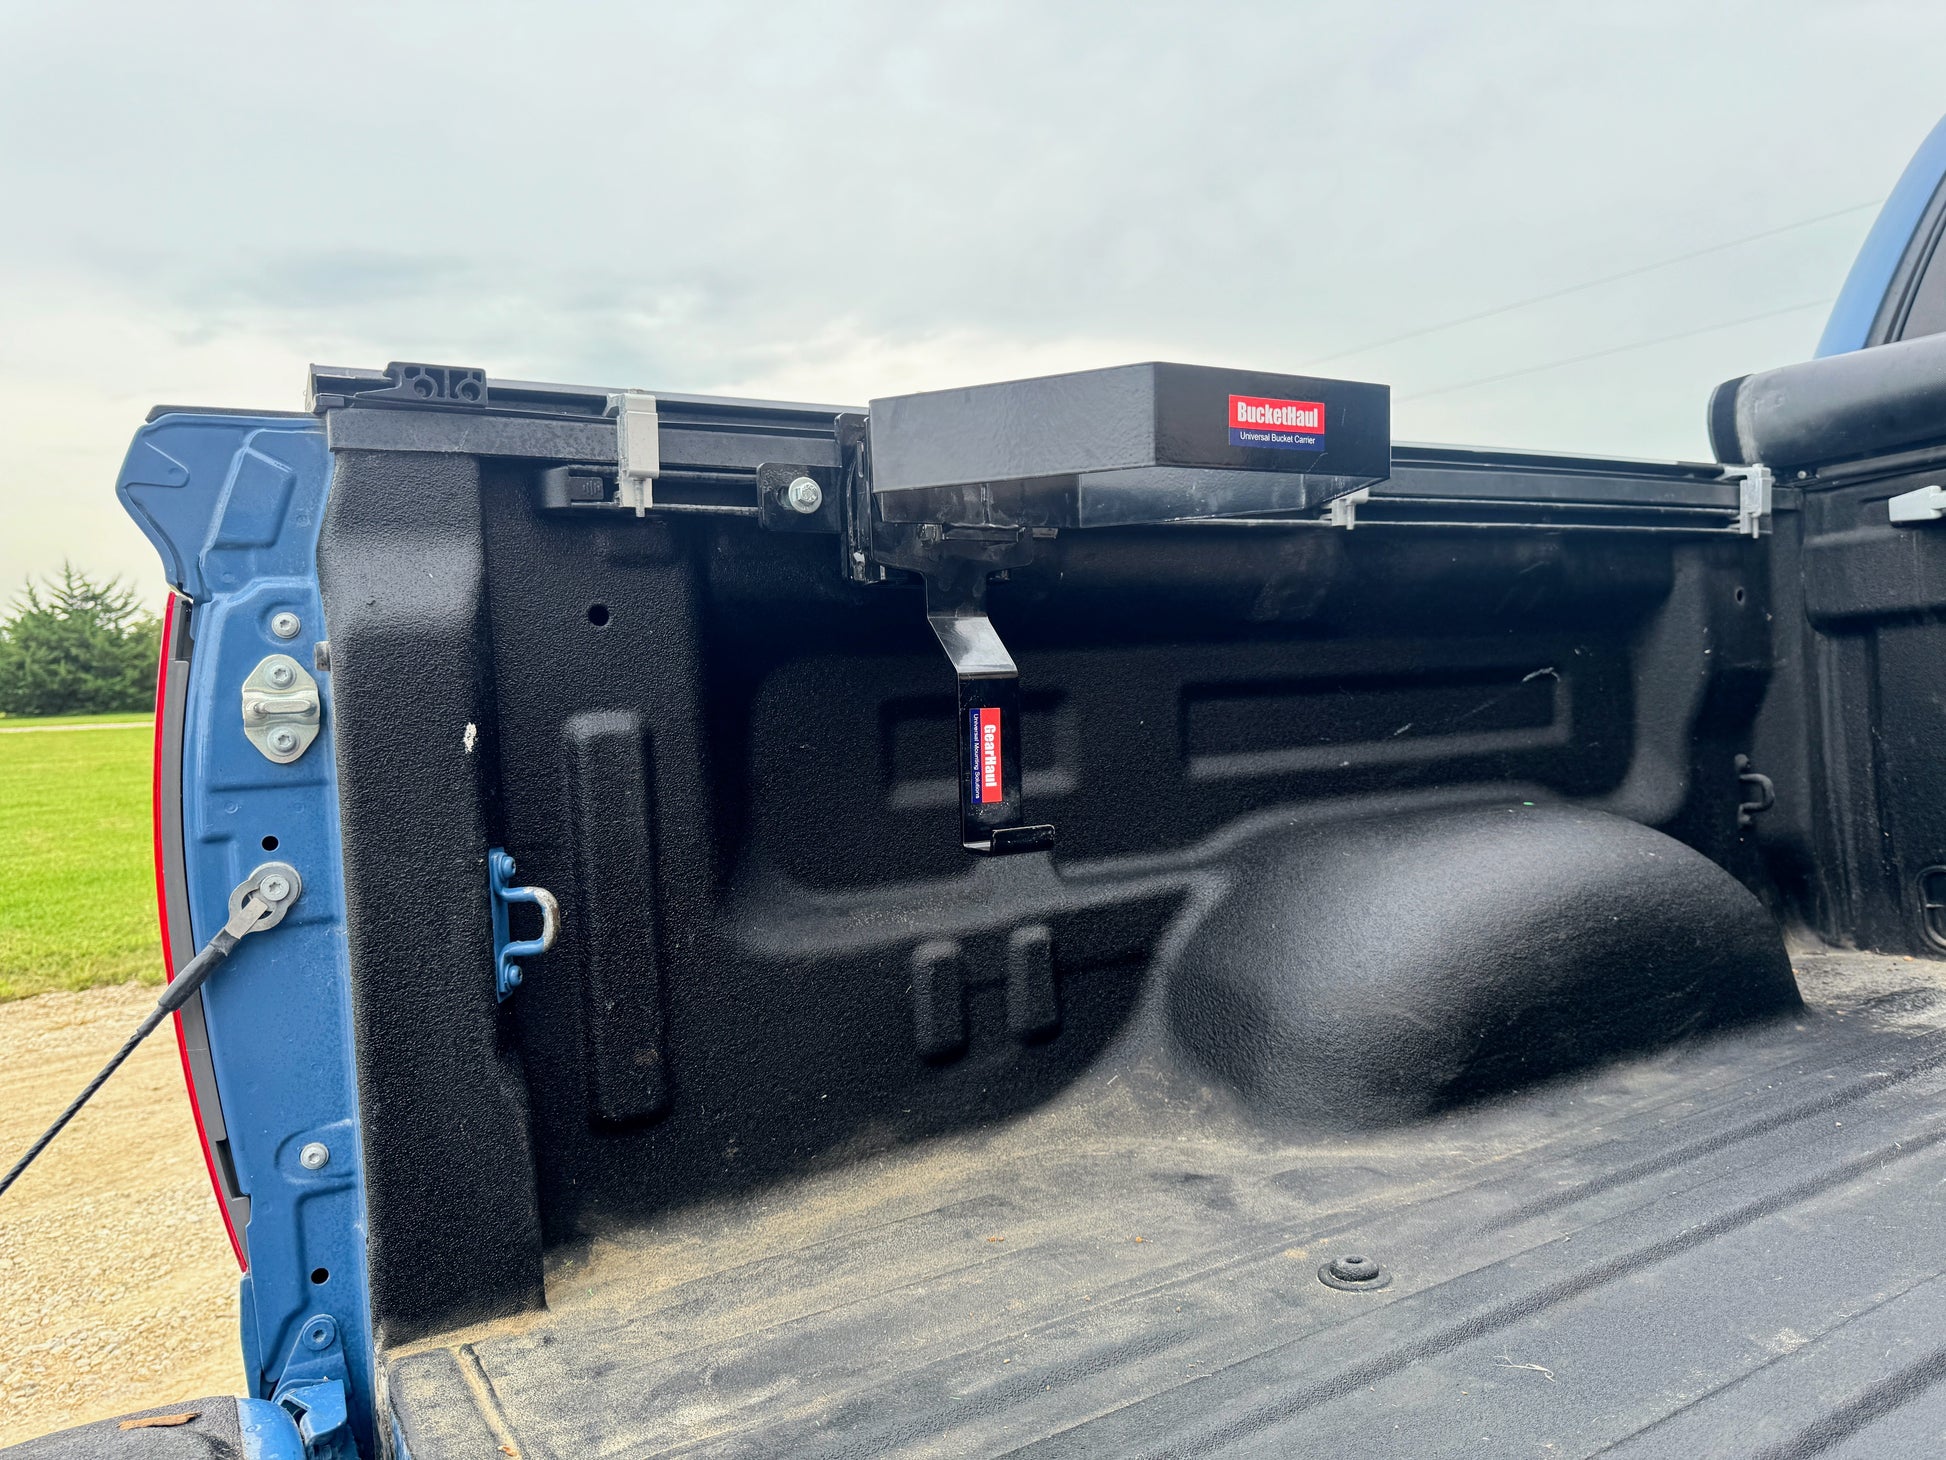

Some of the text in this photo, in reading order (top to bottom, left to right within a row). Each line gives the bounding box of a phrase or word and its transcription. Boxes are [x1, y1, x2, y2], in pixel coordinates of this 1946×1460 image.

[1237, 401, 1318, 428] BucketHaul
[1240, 431, 1316, 445] Universal Bucket Carrier
[984, 724, 997, 787] GearHaul
